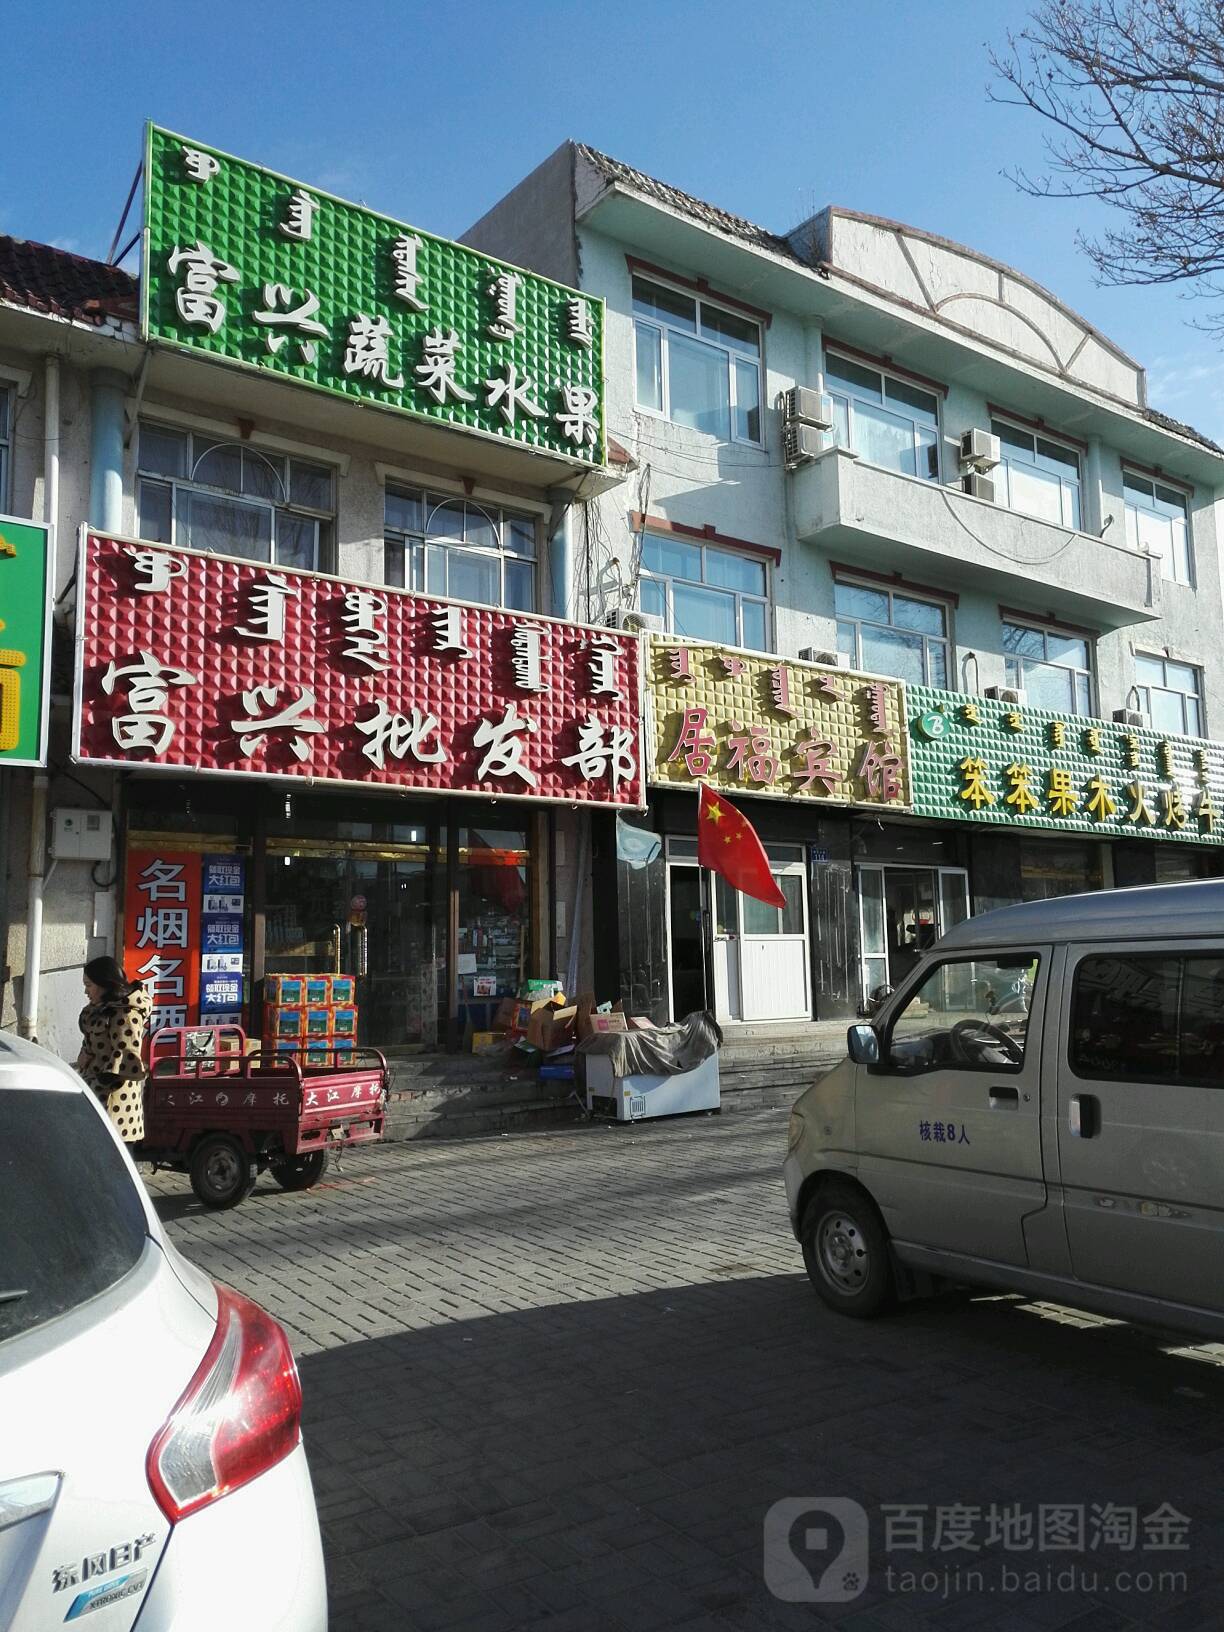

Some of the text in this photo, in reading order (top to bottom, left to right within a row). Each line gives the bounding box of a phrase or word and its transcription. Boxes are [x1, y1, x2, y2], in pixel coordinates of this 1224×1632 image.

[167, 241, 600, 446] 富兴蔬菜水果
[101, 651, 637, 796] 富兴批发部
[669, 706, 904, 802] 居福宾馆
[51, 1532, 157, 1594] 东风日产
